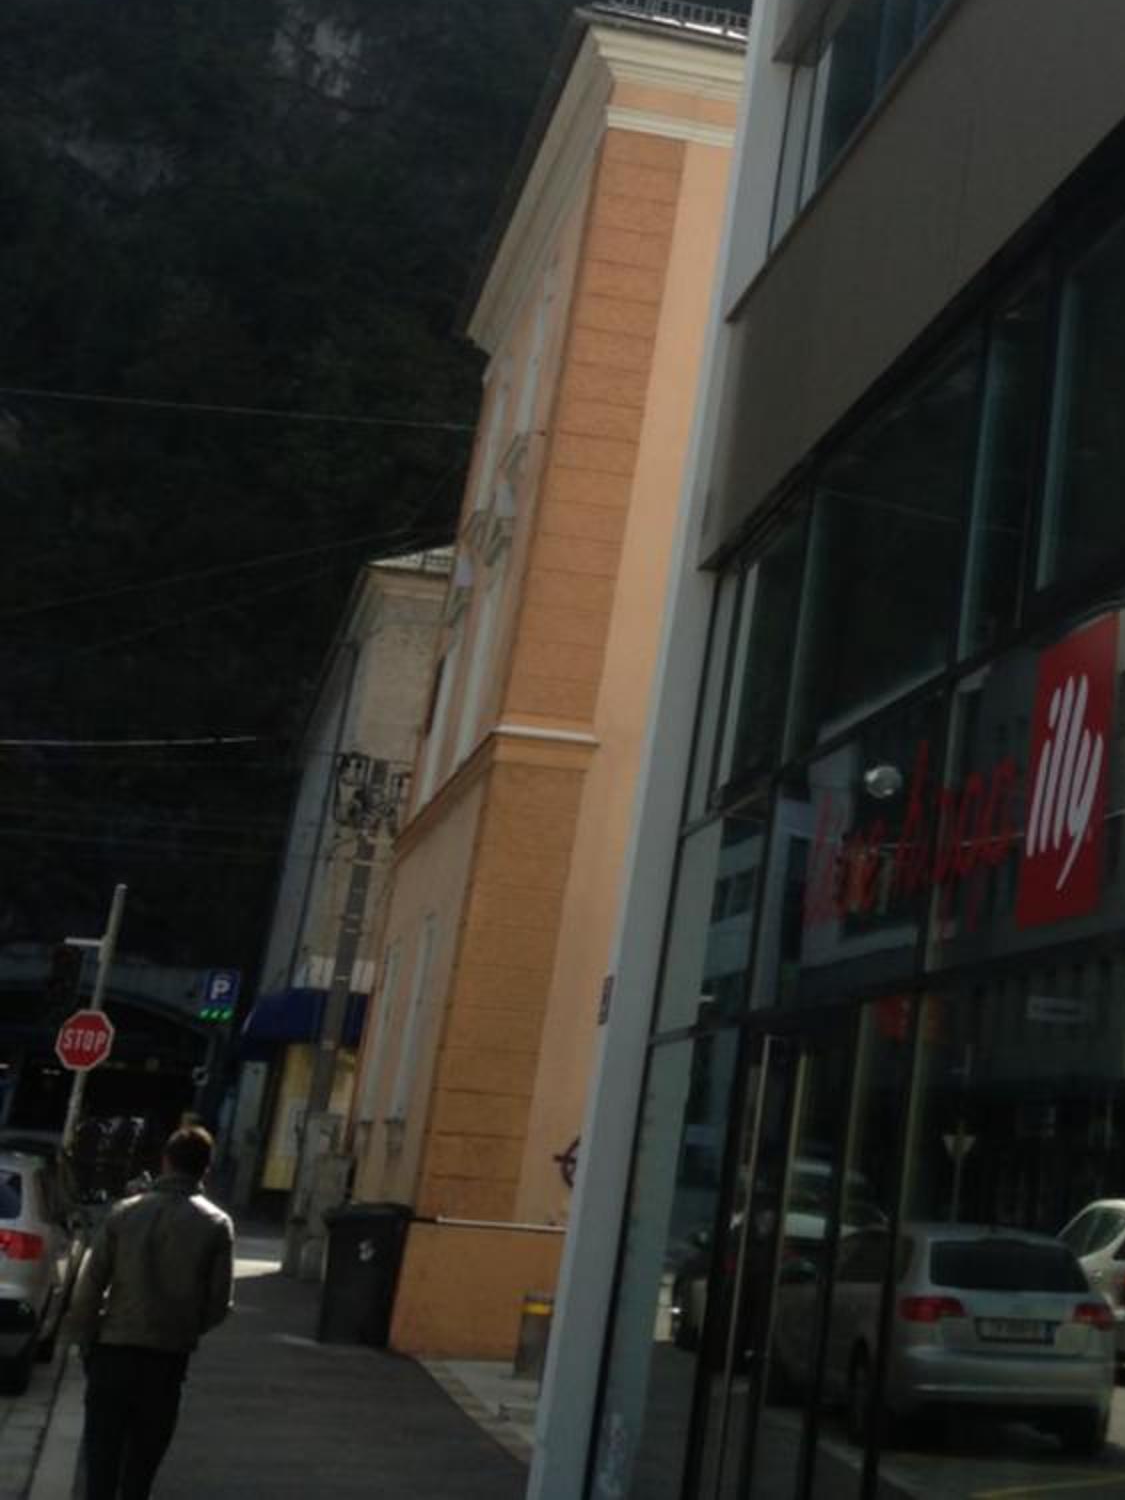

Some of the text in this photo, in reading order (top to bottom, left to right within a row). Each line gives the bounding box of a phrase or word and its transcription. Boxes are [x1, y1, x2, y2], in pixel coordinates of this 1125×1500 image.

[1026, 673, 1104, 891] illy
[210, 977, 231, 1000] P
[64, 1029, 107, 1053] STOP
